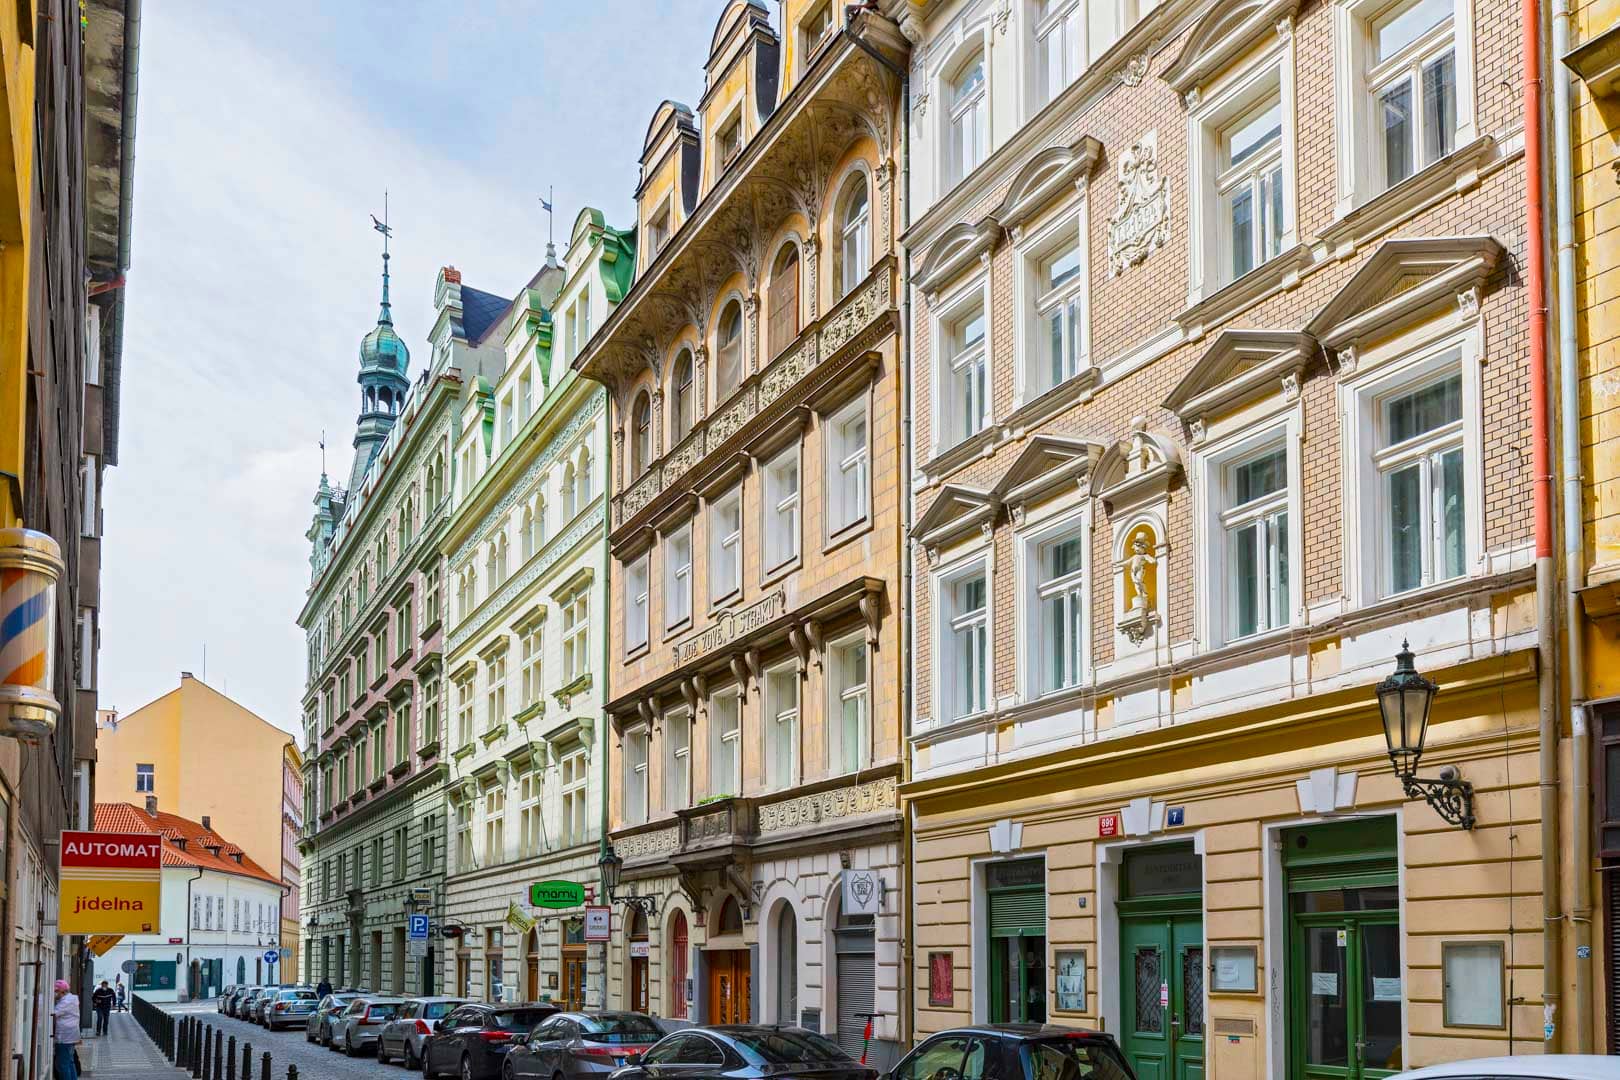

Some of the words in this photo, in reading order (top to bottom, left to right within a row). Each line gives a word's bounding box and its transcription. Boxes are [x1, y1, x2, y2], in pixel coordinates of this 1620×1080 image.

[1172, 812, 1177, 822] 7
[65, 842, 160, 857] AUTOMAT
[537, 889, 578, 902] mamy
[73, 896, 143, 913] jídelna
